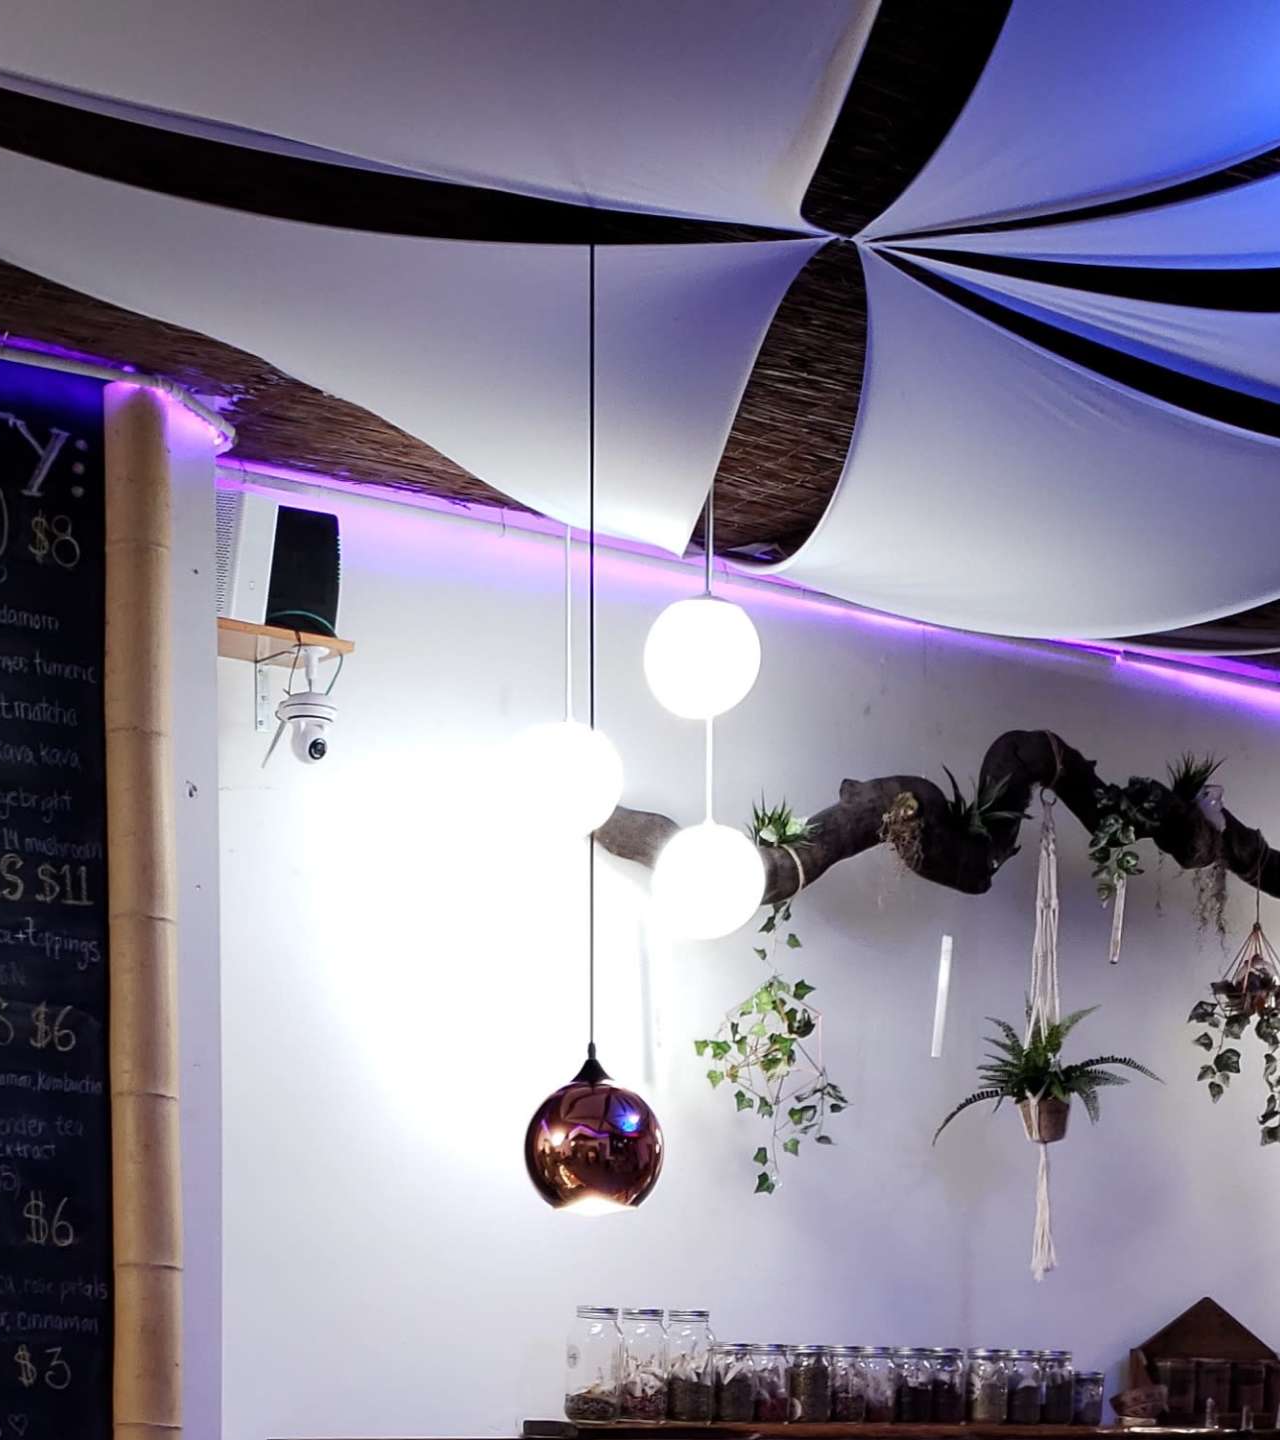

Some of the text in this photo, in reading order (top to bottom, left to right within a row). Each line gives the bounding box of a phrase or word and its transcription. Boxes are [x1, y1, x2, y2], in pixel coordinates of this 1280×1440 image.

[28, 509, 80, 567] $8
[34, 861, 95, 906] $11
[29, 999, 78, 1052] $6
[21, 1189, 75, 1247] $6
[14, 1344, 72, 1391] $3
